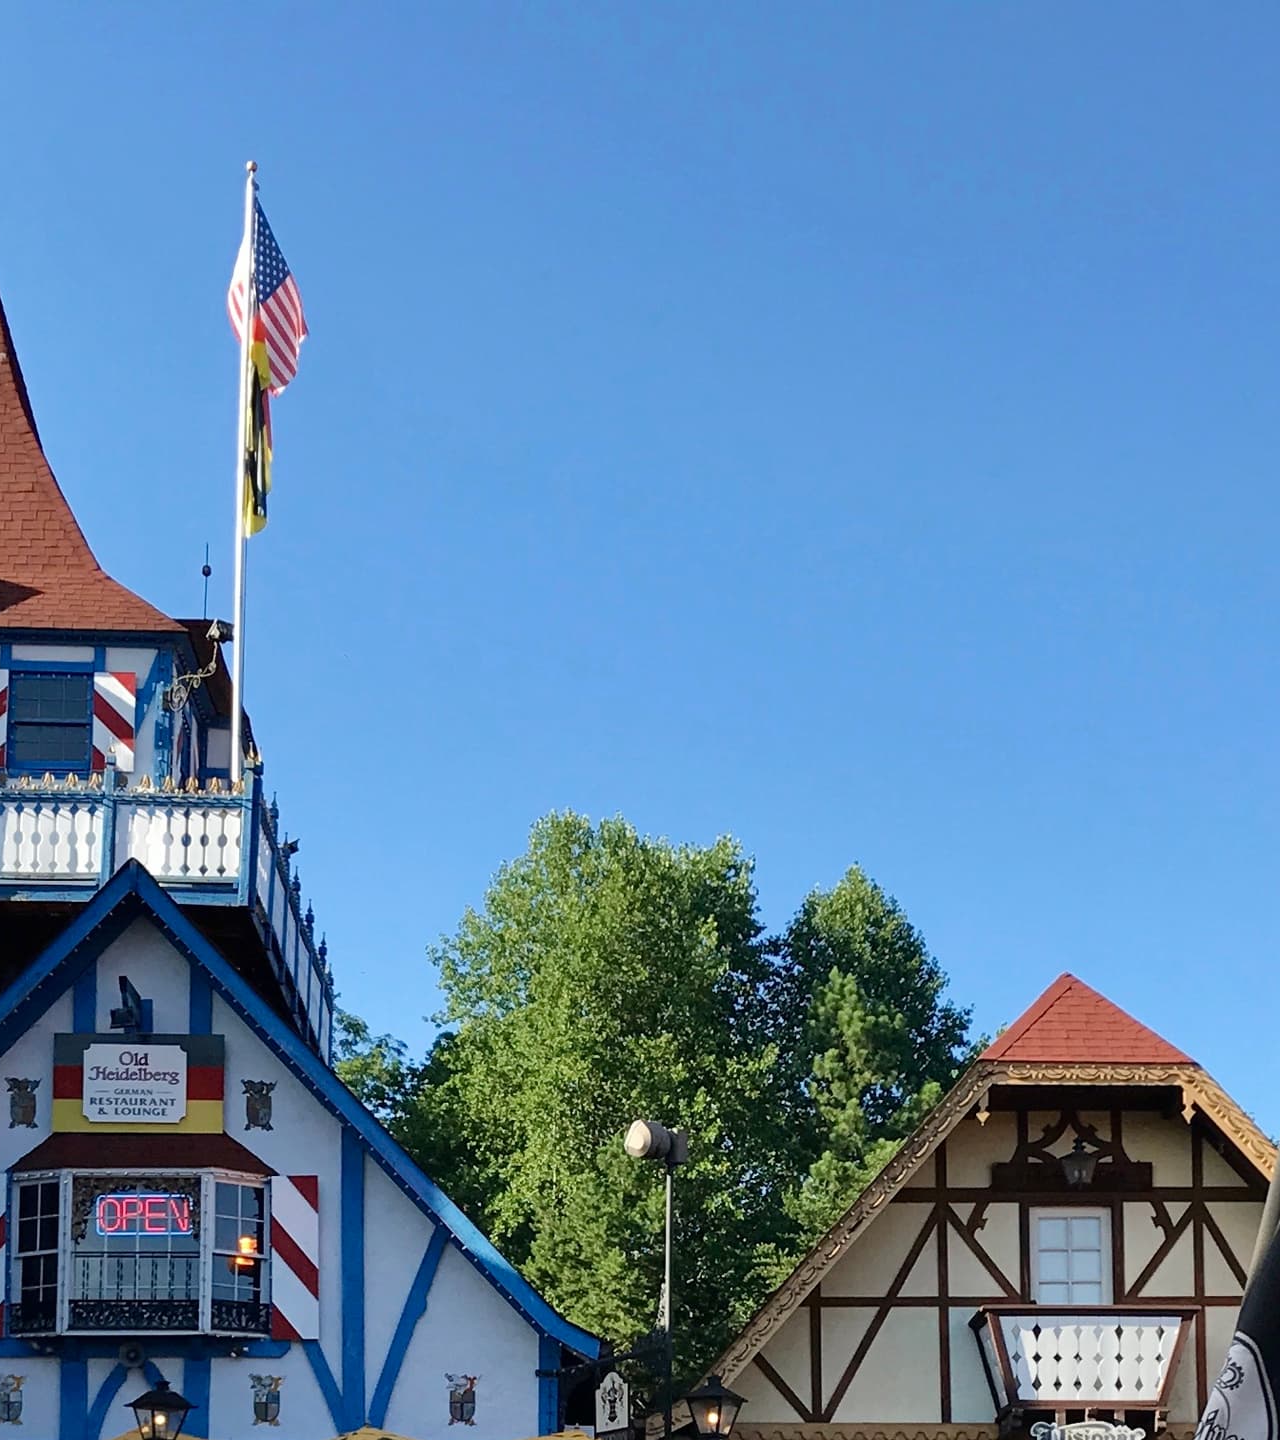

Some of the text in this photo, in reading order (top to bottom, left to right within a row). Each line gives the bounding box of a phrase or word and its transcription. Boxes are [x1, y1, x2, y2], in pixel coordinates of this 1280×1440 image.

[119, 1051, 149, 1066] Old
[88, 1066, 180, 1085] Heidelberg
[114, 1088, 153, 1096] GERMAN
[89, 1097, 177, 1107] RESTAURANT
[97, 1107, 168, 1116] & LOUNGE
[100, 1198, 188, 1232] OPEN
